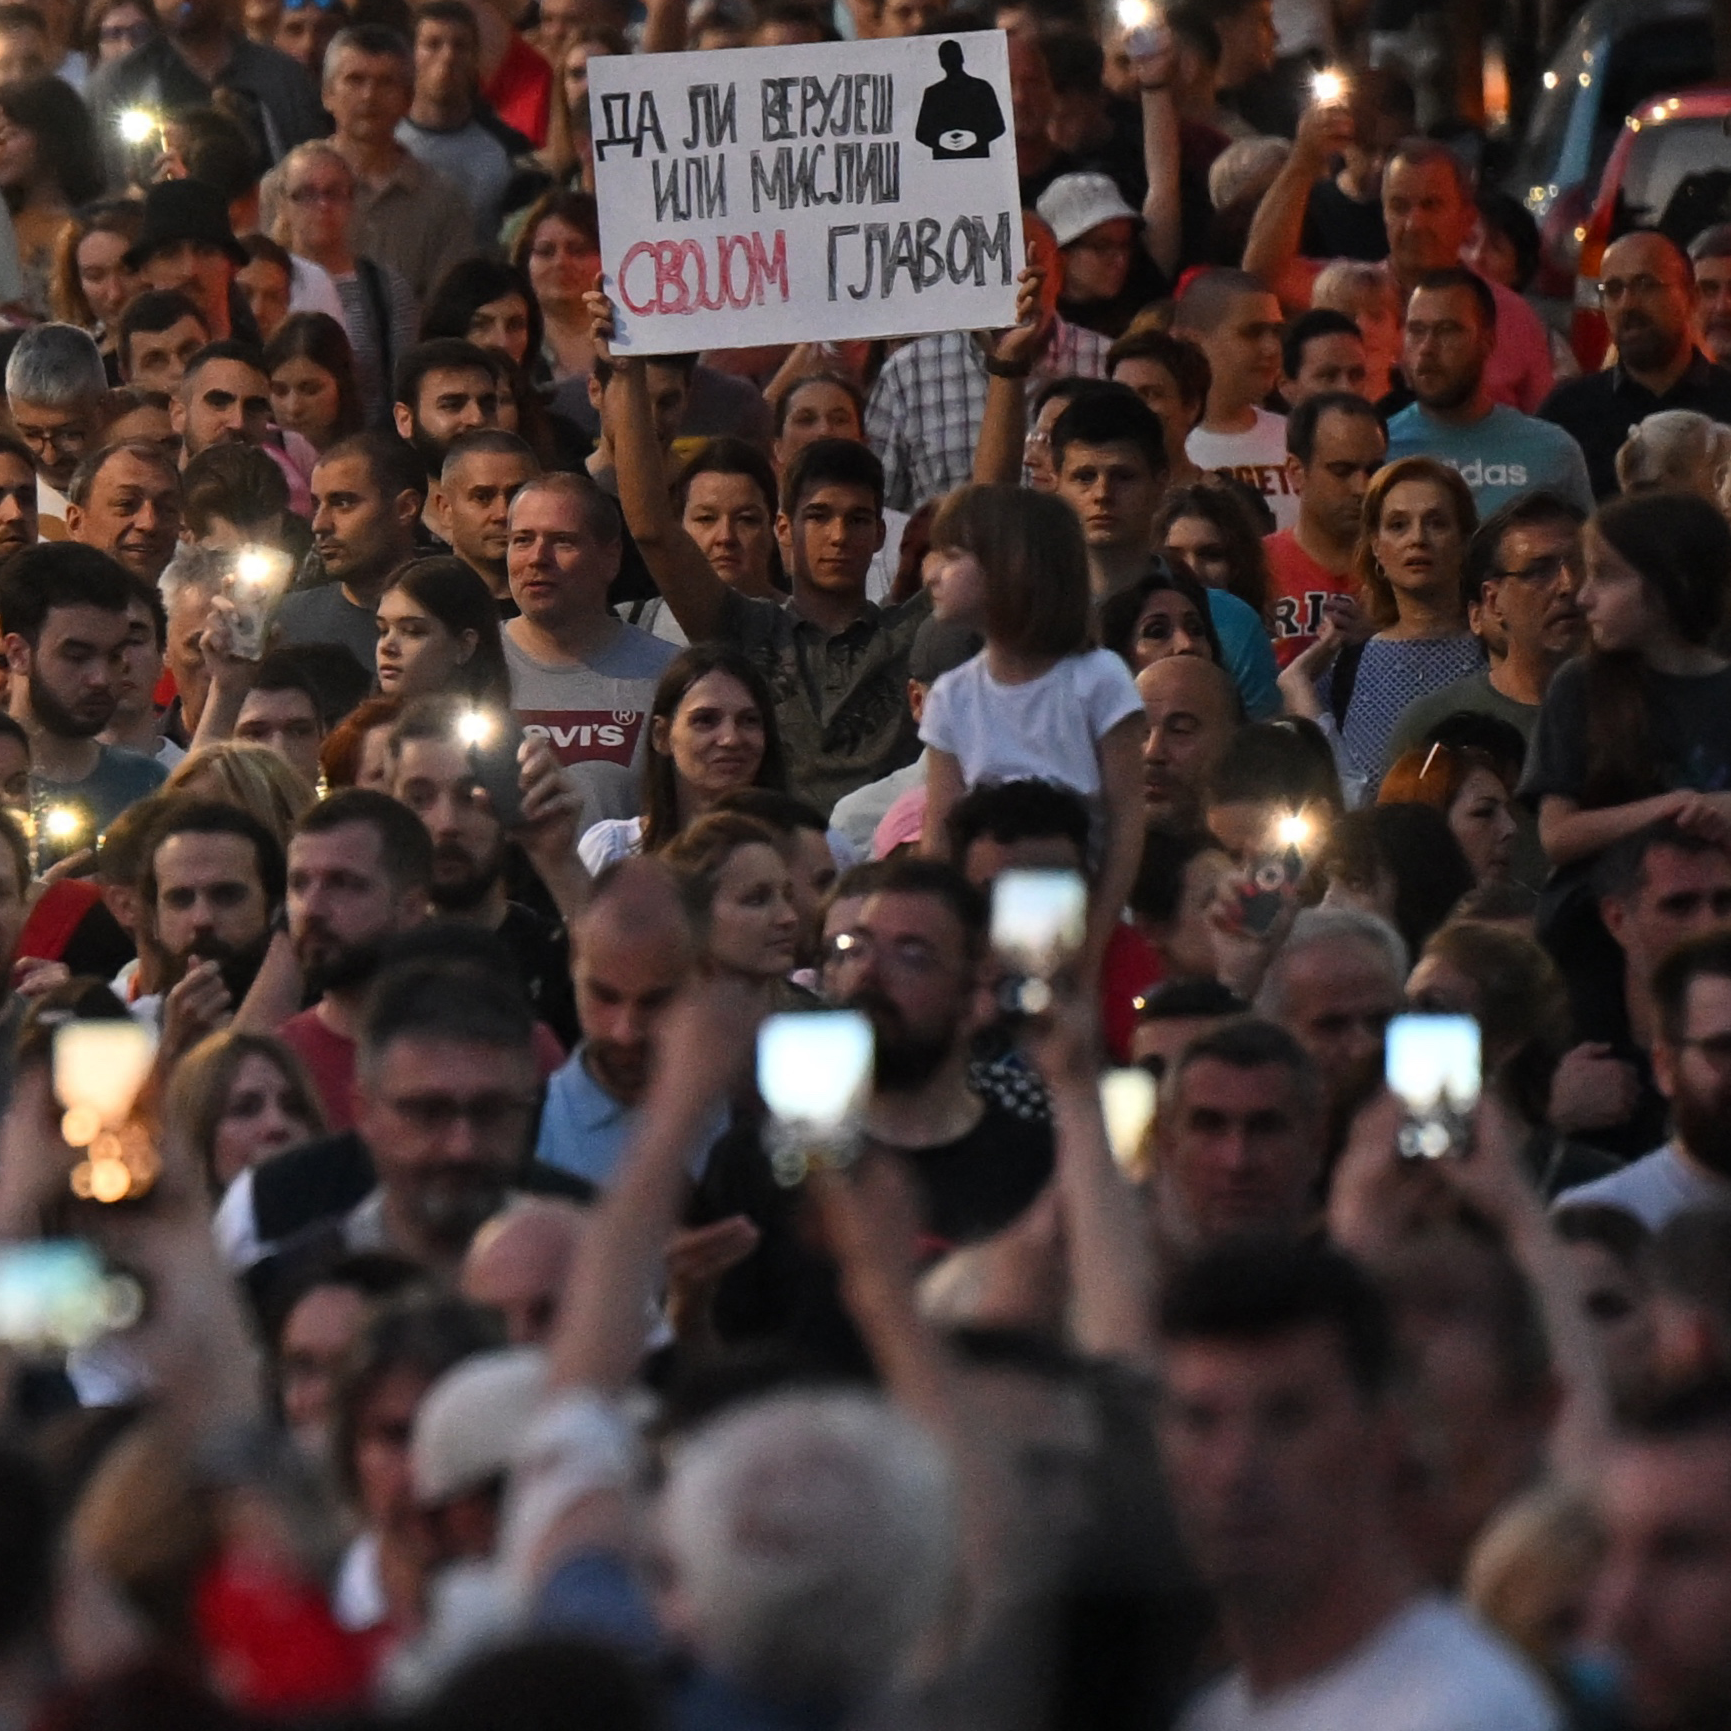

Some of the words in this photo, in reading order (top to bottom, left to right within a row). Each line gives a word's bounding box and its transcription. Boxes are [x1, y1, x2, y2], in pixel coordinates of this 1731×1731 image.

[596, 90, 667, 161] ДА
[682, 82, 738, 151] ЛИ
[761, 73, 894, 143] ВЕРУЈЕШ
[652, 154, 728, 222] ИЛИ
[750, 141, 901, 213] МИСЛИШ
[618, 229, 790, 317] СВОЈОМ
[827, 211, 1012, 302] ГЛАВОМ
